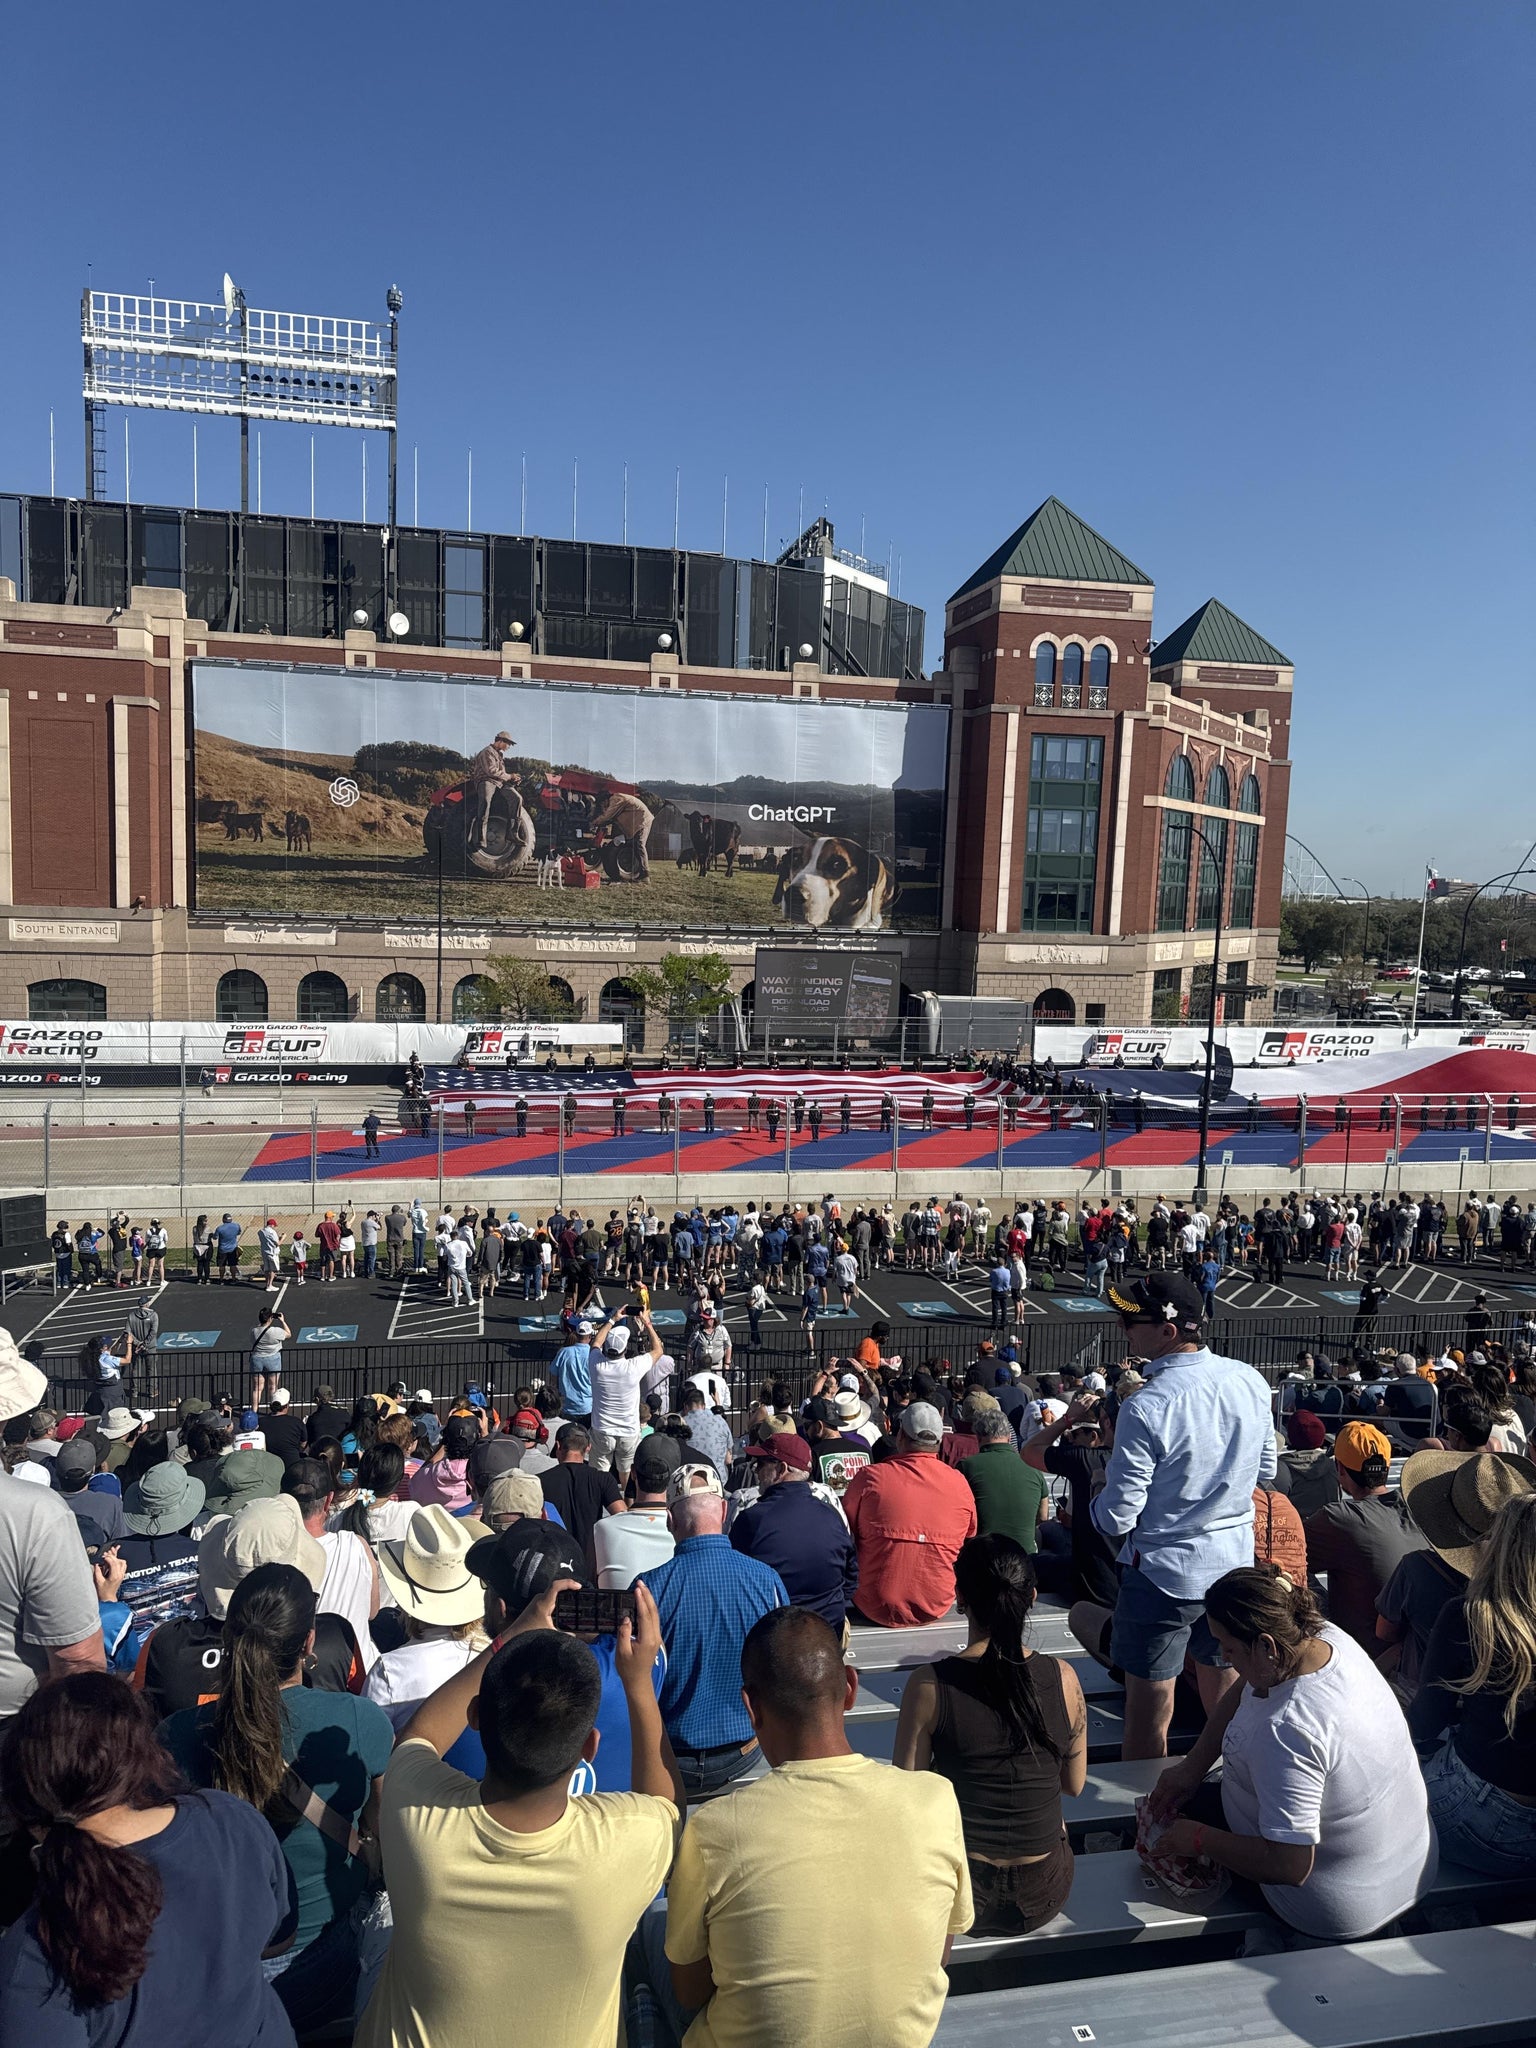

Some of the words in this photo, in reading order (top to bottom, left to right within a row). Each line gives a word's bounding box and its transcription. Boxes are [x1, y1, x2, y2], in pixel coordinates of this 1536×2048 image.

[748, 803, 836, 824] ChatGPT
[16, 924, 54, 934] SOUTH
[59, 925, 117, 935] ENTRANCE
[761, 976, 791, 986] WAY
[804, 987, 841, 996] EASY
[10, 1028, 103, 1041] GAZOO
[7, 1042, 99, 1059] Racing
[224, 1039, 264, 1053] GR
[266, 1039, 321, 1052] CUP
[1122, 1042, 1167, 1053] CUP
[1258, 1041, 1306, 1057] GR
[1309, 1034, 1375, 1044] GAZOO
[45, 1073, 101, 1084] Racing
[234, 1072, 292, 1082] GAZOO
[295, 1072, 348, 1083] Racing
[611, 1226, 623, 1236] 28
[843, 1456, 867, 1468] POINT
[1277, 1516, 1287, 1526] OF
